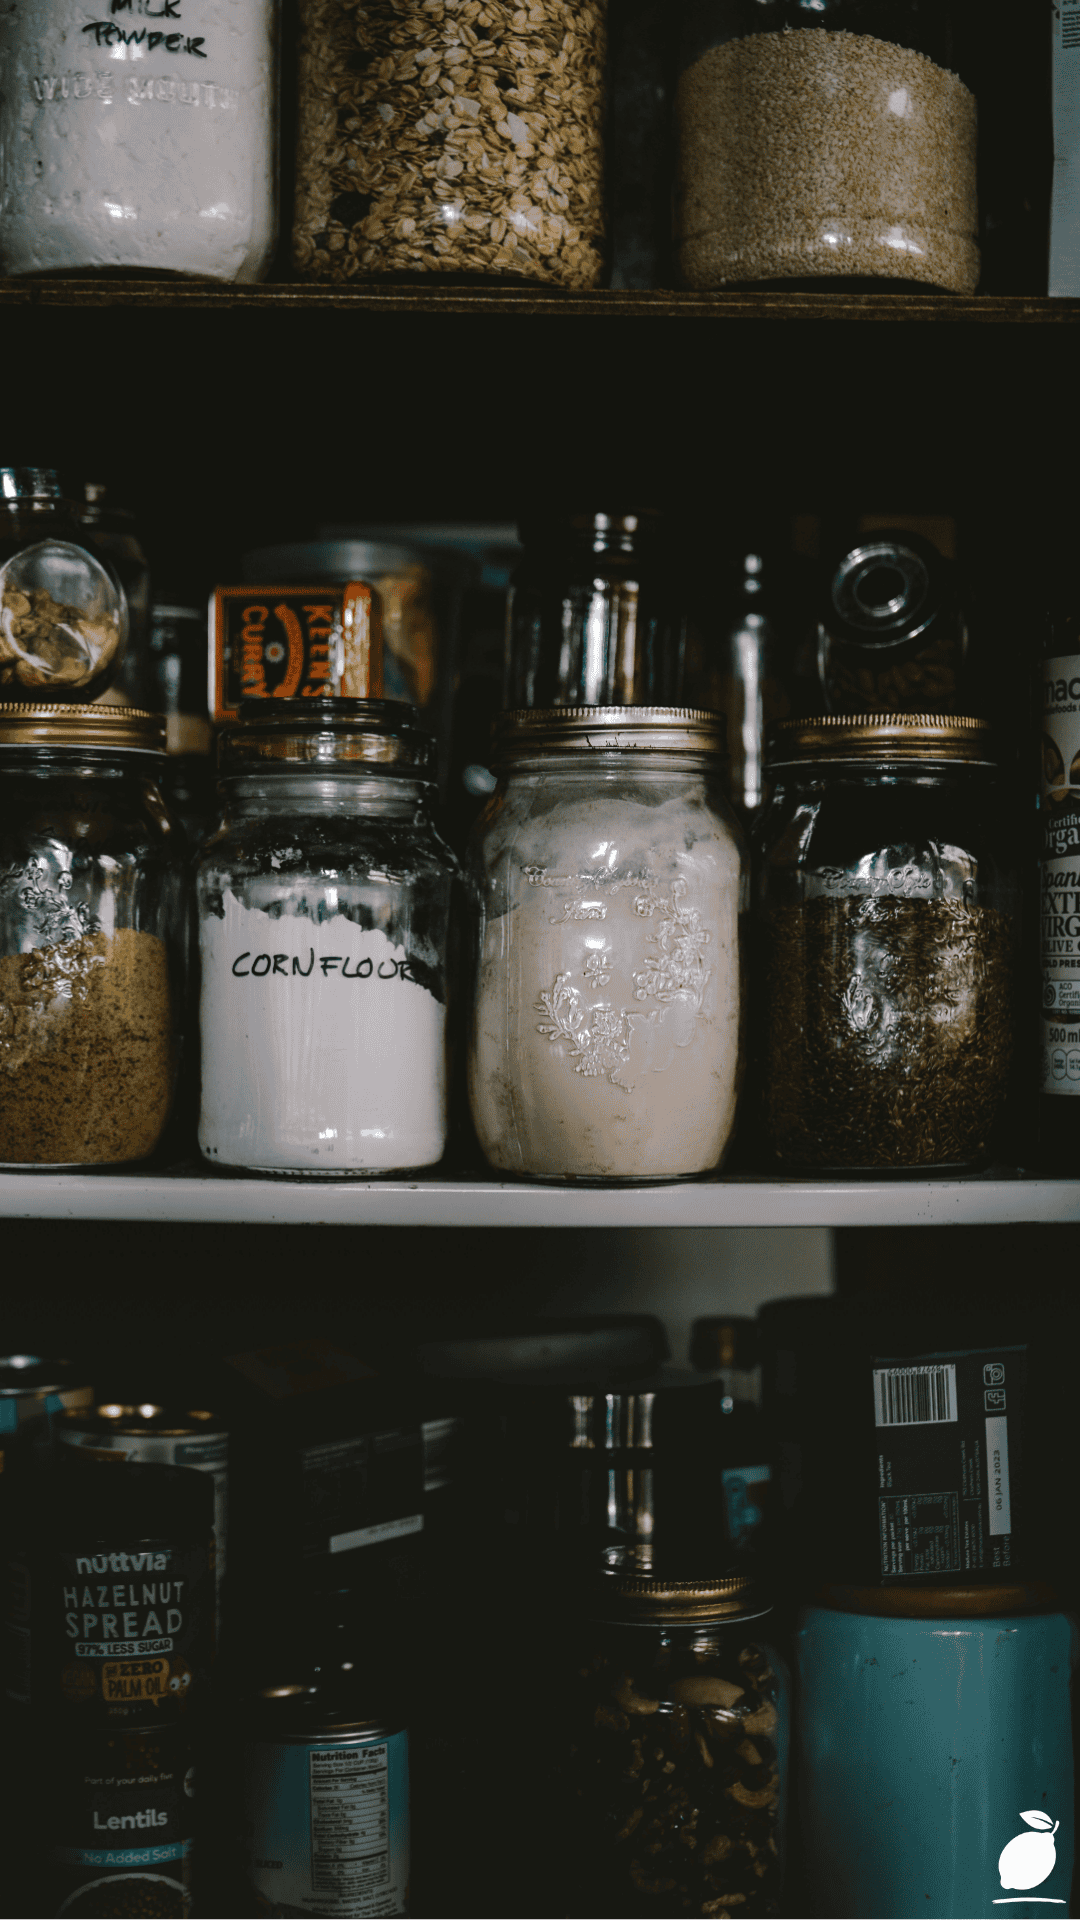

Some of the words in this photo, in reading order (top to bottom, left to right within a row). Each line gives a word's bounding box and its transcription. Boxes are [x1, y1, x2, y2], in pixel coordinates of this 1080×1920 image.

[83, 21, 207, 57] POWDER
[242, 606, 272, 698] CURRY
[232, 947, 417, 983] CORNFLOUR
[1049, 1028, 1066, 1043] 500
[993, 1450, 1001, 1474] 2023
[995, 1478, 1003, 1496] JAN
[995, 1498, 1002, 1511] 06
[993, 1547, 1001, 1567] Best
[1003, 1535, 1011, 1566] Before
[63, 1581, 184, 1608] HAZELNUT
[65, 1608, 183, 1638] SPREAD
[77, 1643, 105, 1655] 97%
[108, 1643, 135, 1654] LESS
[138, 1638, 171, 1652] SUGAR
[120, 1660, 163, 1677] ZERO
[108, 1678, 142, 1699] PALM
[145, 1676, 166, 1696] OIL
[312, 1751, 358, 1761] Nutrition
[362, 1747, 386, 1758] Facts
[116, 1777, 136, 1787] your
[137, 1774, 159, 1785] daily
[93, 1808, 169, 1830] Lentils
[84, 1852, 103, 1864] No
[105, 1850, 150, 1864] Added
[152, 1847, 178, 1862] Salt
